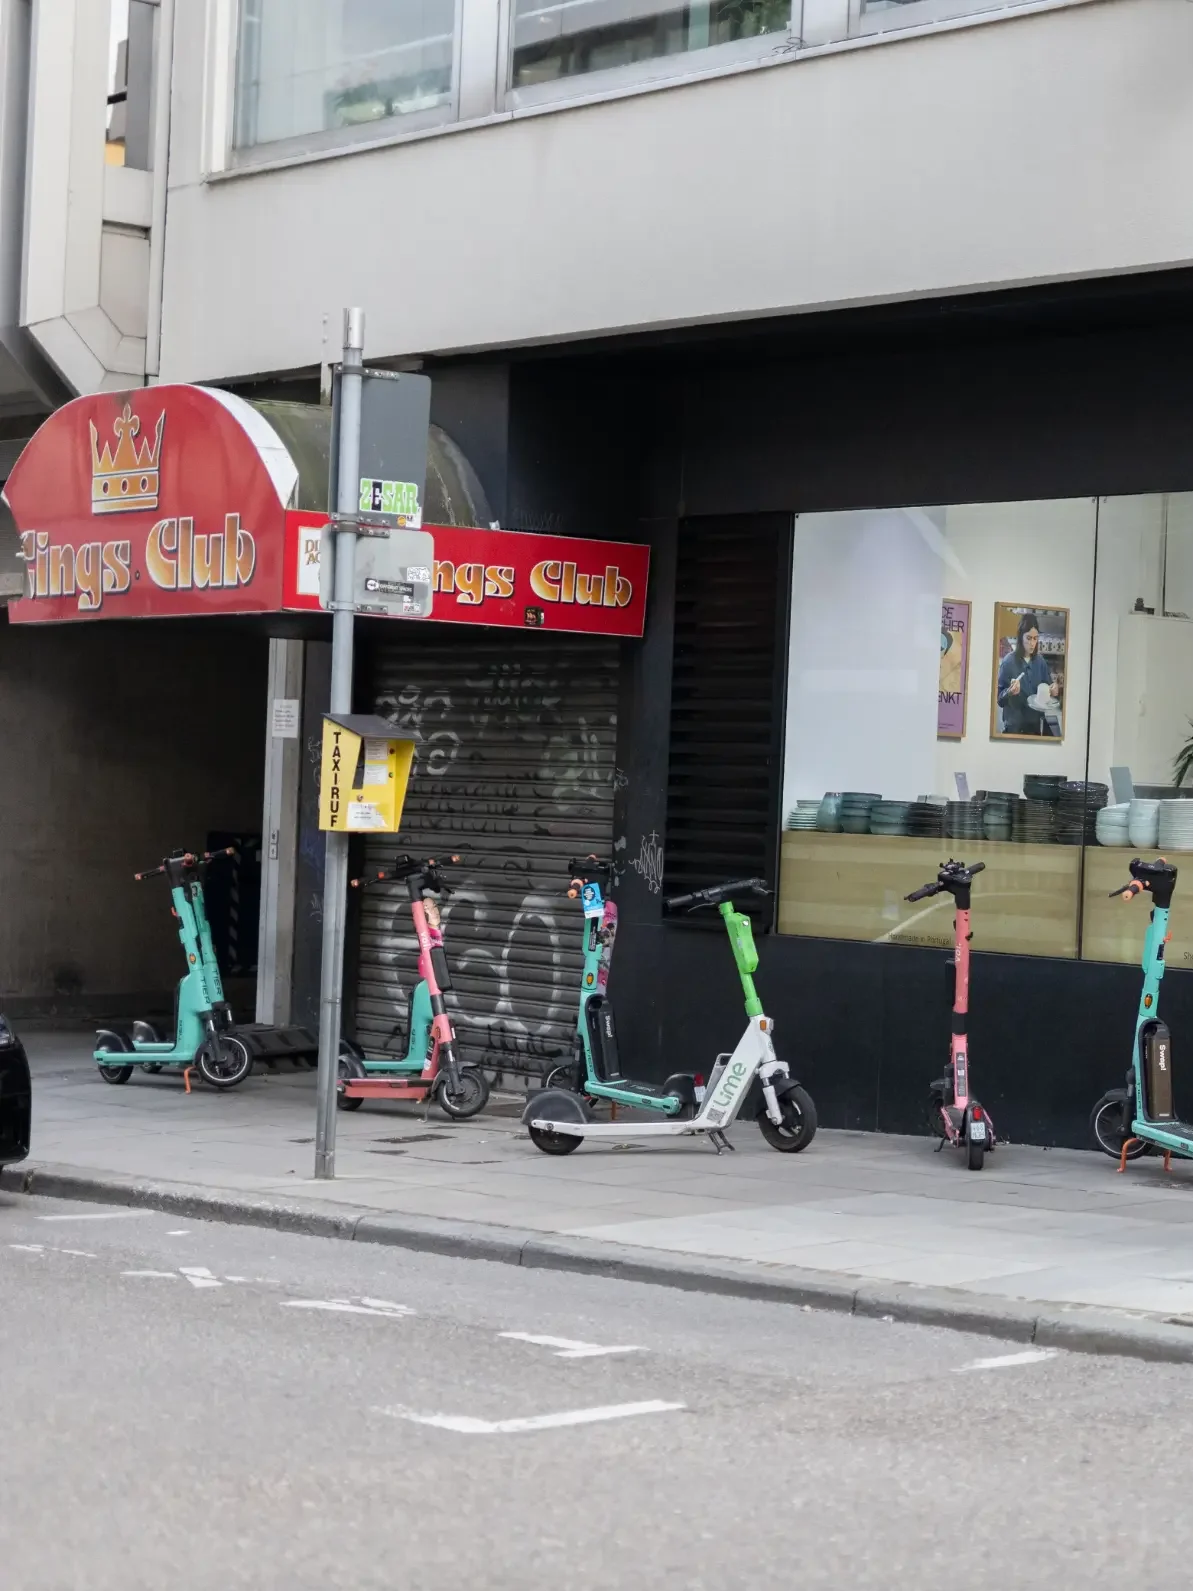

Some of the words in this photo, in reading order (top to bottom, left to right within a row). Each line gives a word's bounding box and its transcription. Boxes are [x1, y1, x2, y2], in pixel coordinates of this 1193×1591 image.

[360, 478, 418, 514] ZESAR
[145, 512, 256, 589] Club
[433, 560, 515, 605] ngs
[529, 560, 633, 607] Club
[941, 619, 965, 633] HER
[330, 731, 342, 828] TAXIRUF
[927, 935, 951, 946] Portugal
[201, 975, 211, 1004] TIER
[212, 967, 222, 995] TIER
[1158, 1044, 1167, 1071] Swap!
[716, 1061, 747, 1108] Lime
